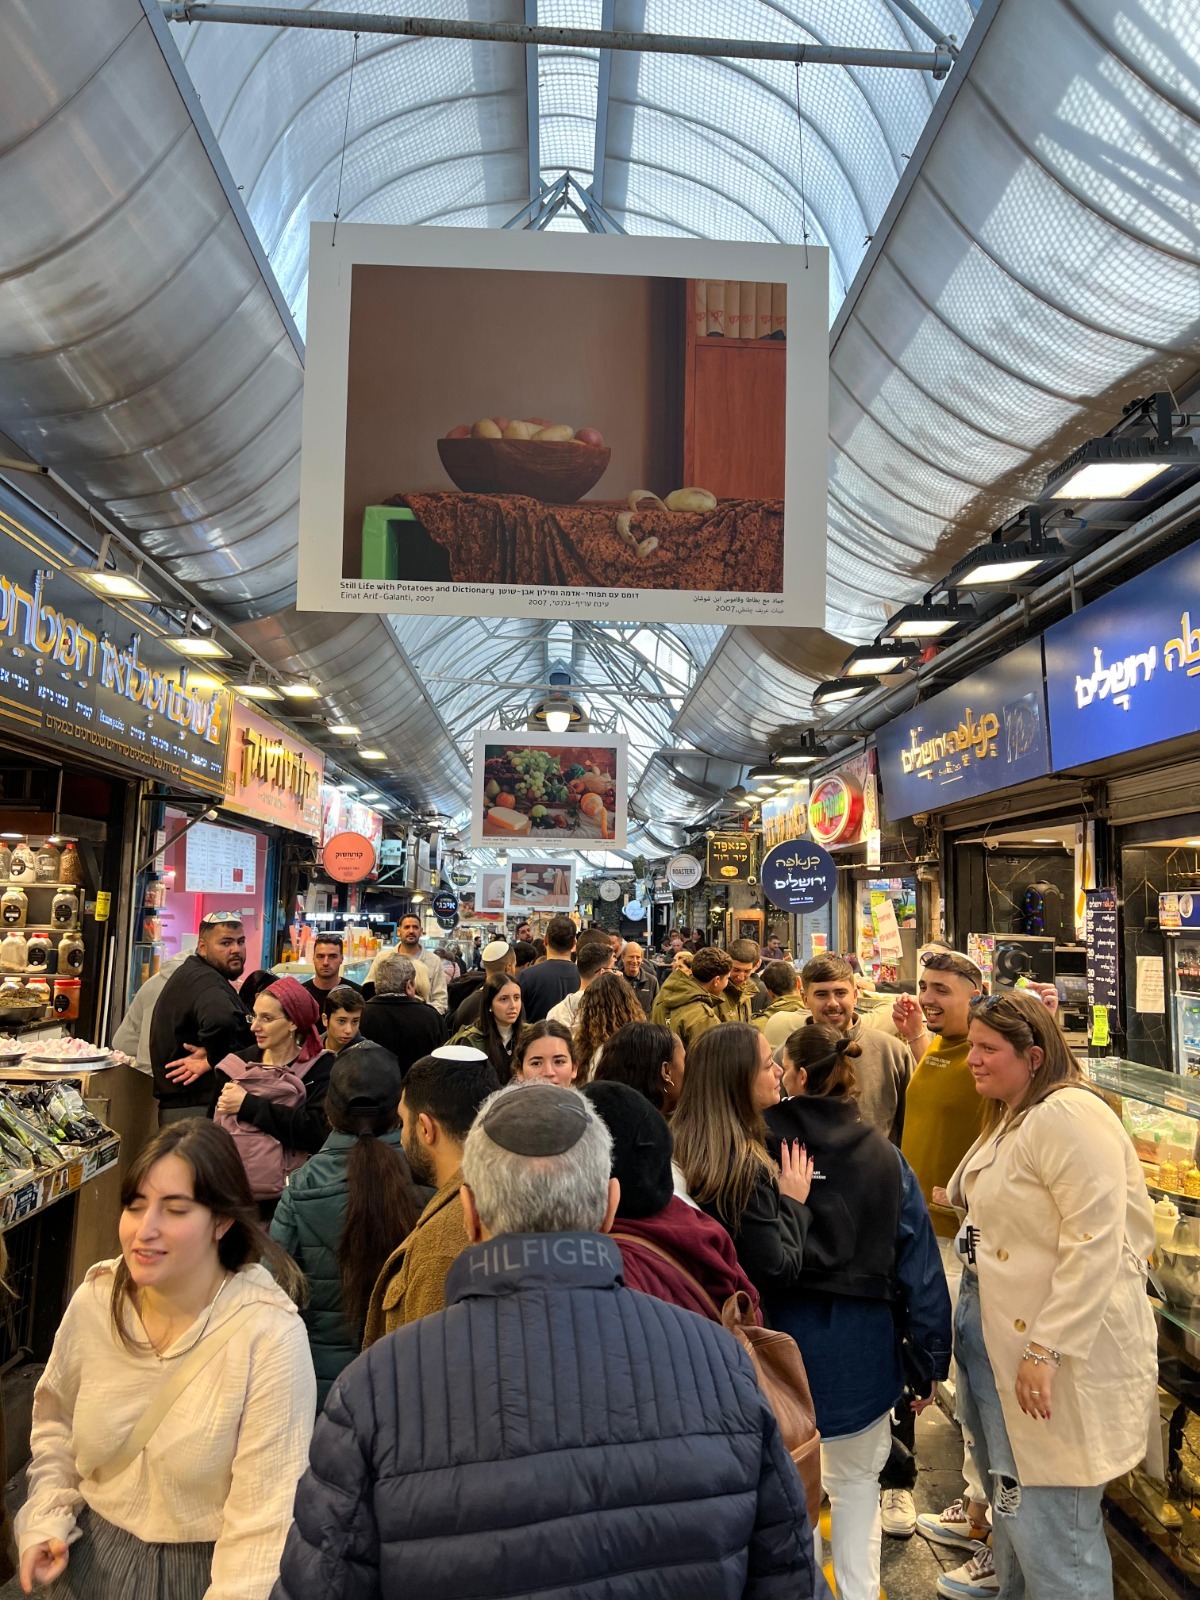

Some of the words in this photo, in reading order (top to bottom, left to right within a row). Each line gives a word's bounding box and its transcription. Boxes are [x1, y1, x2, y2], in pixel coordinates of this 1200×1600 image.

[340, 582, 356, 590] Still
[358, 582, 375, 590] Life
[377, 583, 395, 591] with
[397, 583, 433, 593] Potatoes
[435, 585, 450, 593] and
[452, 585, 495, 596] Dictionary
[537, 588, 558, 597] ומילון
[340, 592, 361, 600] Einat
[415, 595, 435, 603] 2007
[608, 591, 619, 599] עם
[46, 713, 73, 736] במקום
[713, 841, 748, 852] כנאפה
[713, 853, 730, 861] דוד
[733, 854, 748, 862] עיר
[469, 1237, 616, 1283] HILFIGER
